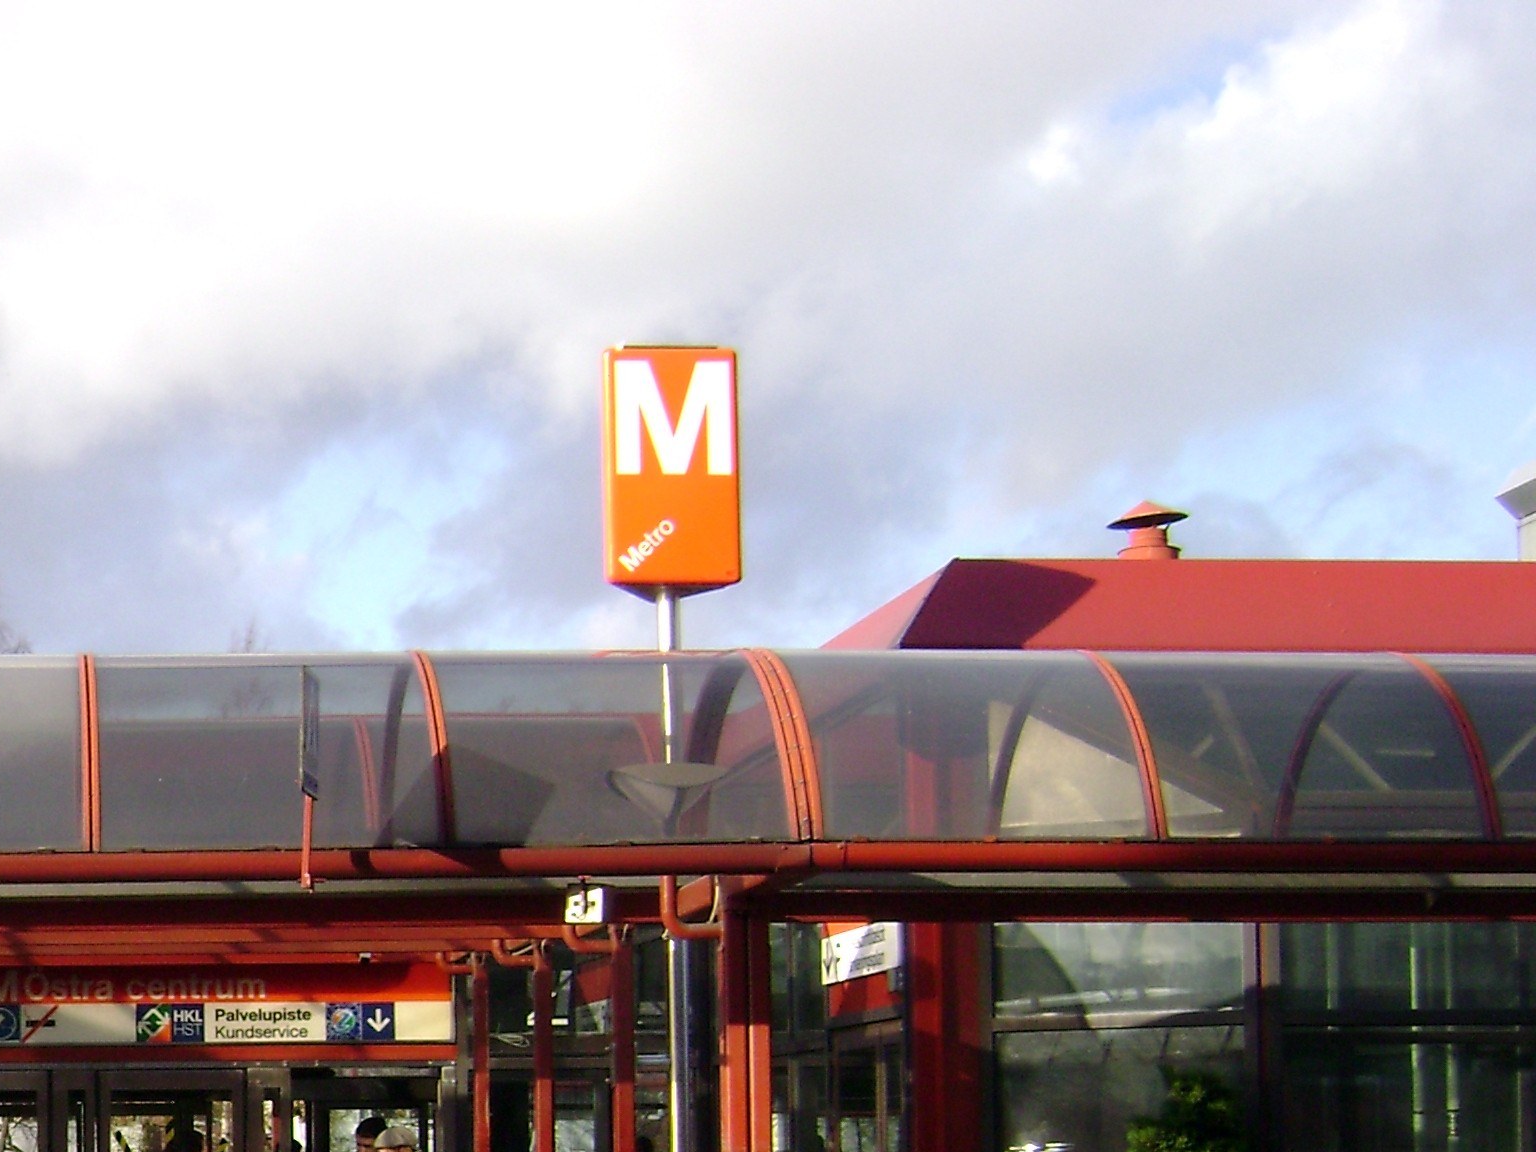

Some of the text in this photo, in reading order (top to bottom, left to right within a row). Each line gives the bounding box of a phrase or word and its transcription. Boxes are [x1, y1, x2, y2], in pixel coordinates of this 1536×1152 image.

[614, 360, 733, 476] M
[618, 518, 676, 572] Metro
[23, 967, 115, 1000] Östra
[126, 974, 267, 1000] centrum
[173, 1010, 203, 1022] HKL
[215, 1008, 312, 1025] Palvelupiste
[173, 1024, 203, 1037] HST
[215, 1026, 309, 1039] Kundservice
